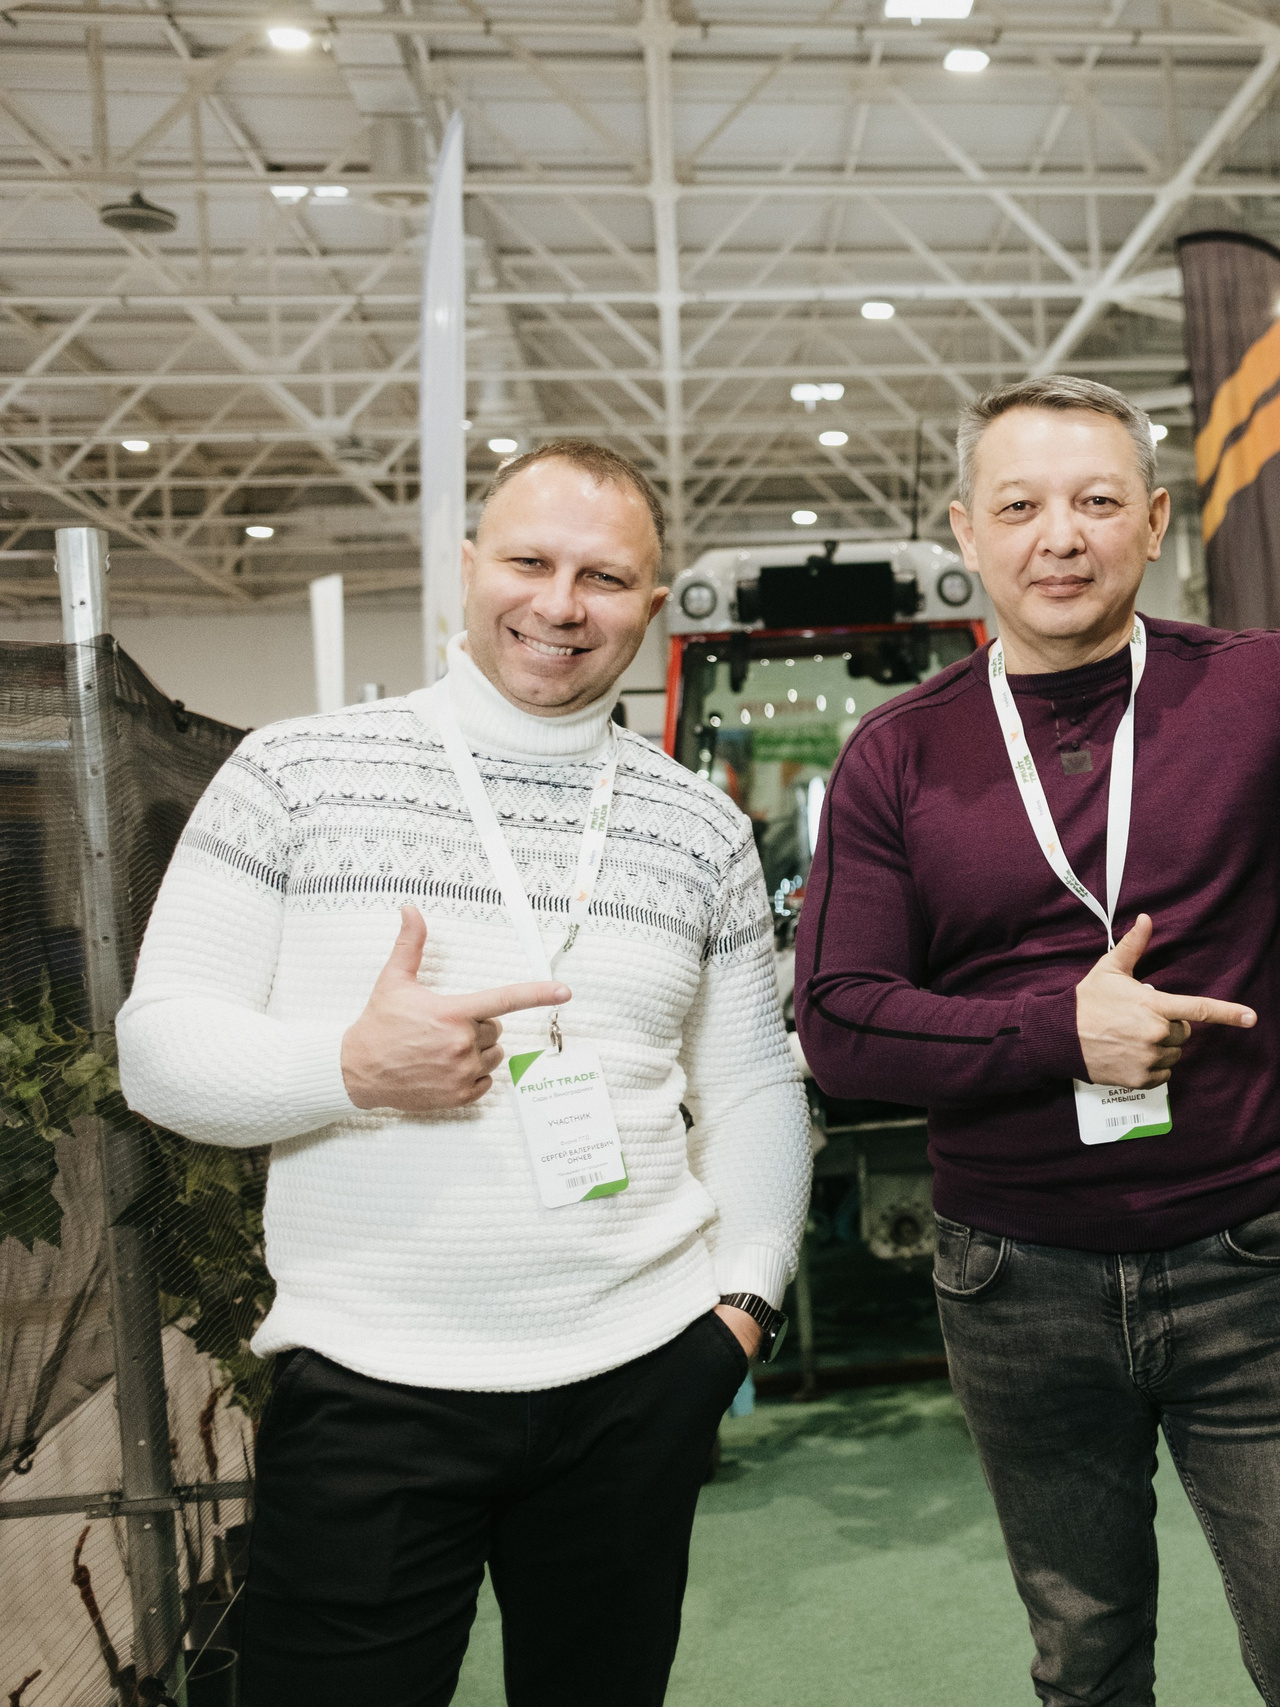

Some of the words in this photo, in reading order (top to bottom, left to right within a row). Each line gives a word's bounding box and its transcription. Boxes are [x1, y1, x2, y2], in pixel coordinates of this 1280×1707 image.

[1101, 1093, 1146, 1105] БАМБЫШЕВ
[548, 1112, 592, 1127] УЧАСТНИК
[541, 1150, 569, 1163] СЕРГЕЙ
[569, 1140, 614, 1157] ВАЛЕРИЕВИЧ
[567, 1153, 593, 1165] ОНЧЕВ
